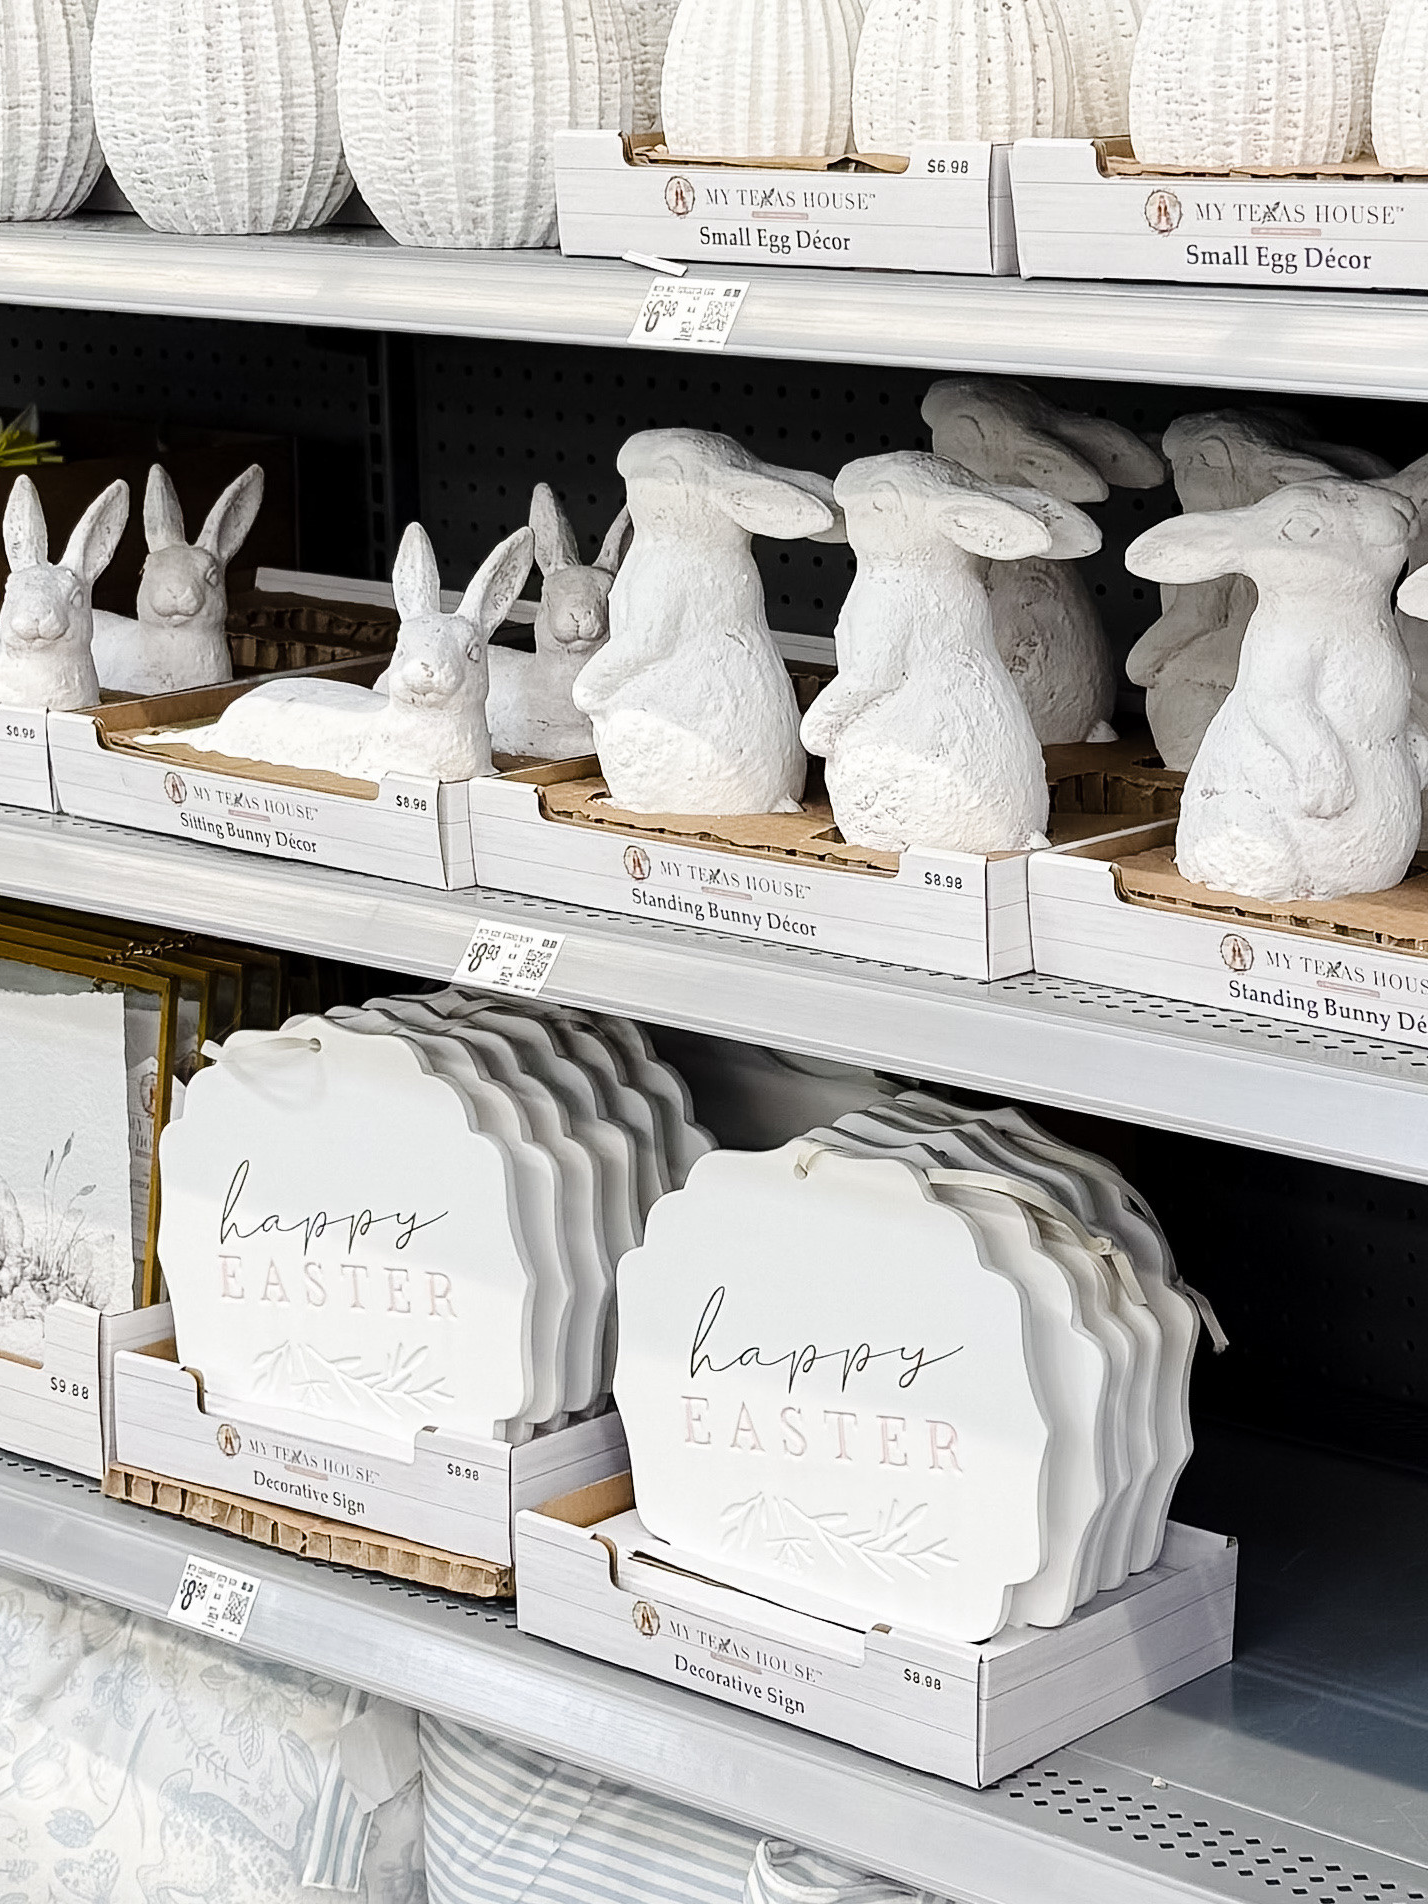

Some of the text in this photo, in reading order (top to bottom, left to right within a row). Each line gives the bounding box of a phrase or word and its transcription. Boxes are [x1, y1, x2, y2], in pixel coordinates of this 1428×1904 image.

[927, 158, 969, 175] $6.98
[705, 188, 731, 205] MY
[736, 187, 797, 209] TEXAS
[1195, 203, 1226, 223] MY
[1233, 201, 1306, 226] TEXAS
[700, 227, 851, 255] Small Egg Décor
[1186, 243, 1372, 275] Small Egg Décor
[193, 785, 213, 801] MY
[216, 788, 260, 812] TEXAS
[396, 794, 428, 812] $8.98
[179, 812, 318, 854] Sitting Bunny Décor
[660, 860, 682, 877] MY
[687, 865, 740, 889] TEXAS
[924, 871, 963, 890] $8.98
[631, 888, 817, 938] Standing Bunny Décor
[1266, 950, 1293, 969] MY
[1300, 957, 1365, 985] TEXAS
[1229, 980, 1319, 1019] Standing
[1324, 997, 1391, 1034] Bunny
[220, 1159, 449, 1256] happy
[218, 1254, 458, 1319] EASTER
[690, 1285, 964, 1394] happy
[51, 1376, 90, 1401] $9.88
[680, 1395, 964, 1474] EASTER
[249, 1439, 270, 1457] MY
[272, 1445, 318, 1470] TEXAS
[447, 1462, 479, 1482] $8.98
[253, 1470, 366, 1515] Decorative Sign
[670, 1621, 691, 1640] MY
[696, 1627, 751, 1662] TEXAS
[674, 1653, 806, 1716] Decorative Sign
[904, 1667, 942, 1691] $8.98
